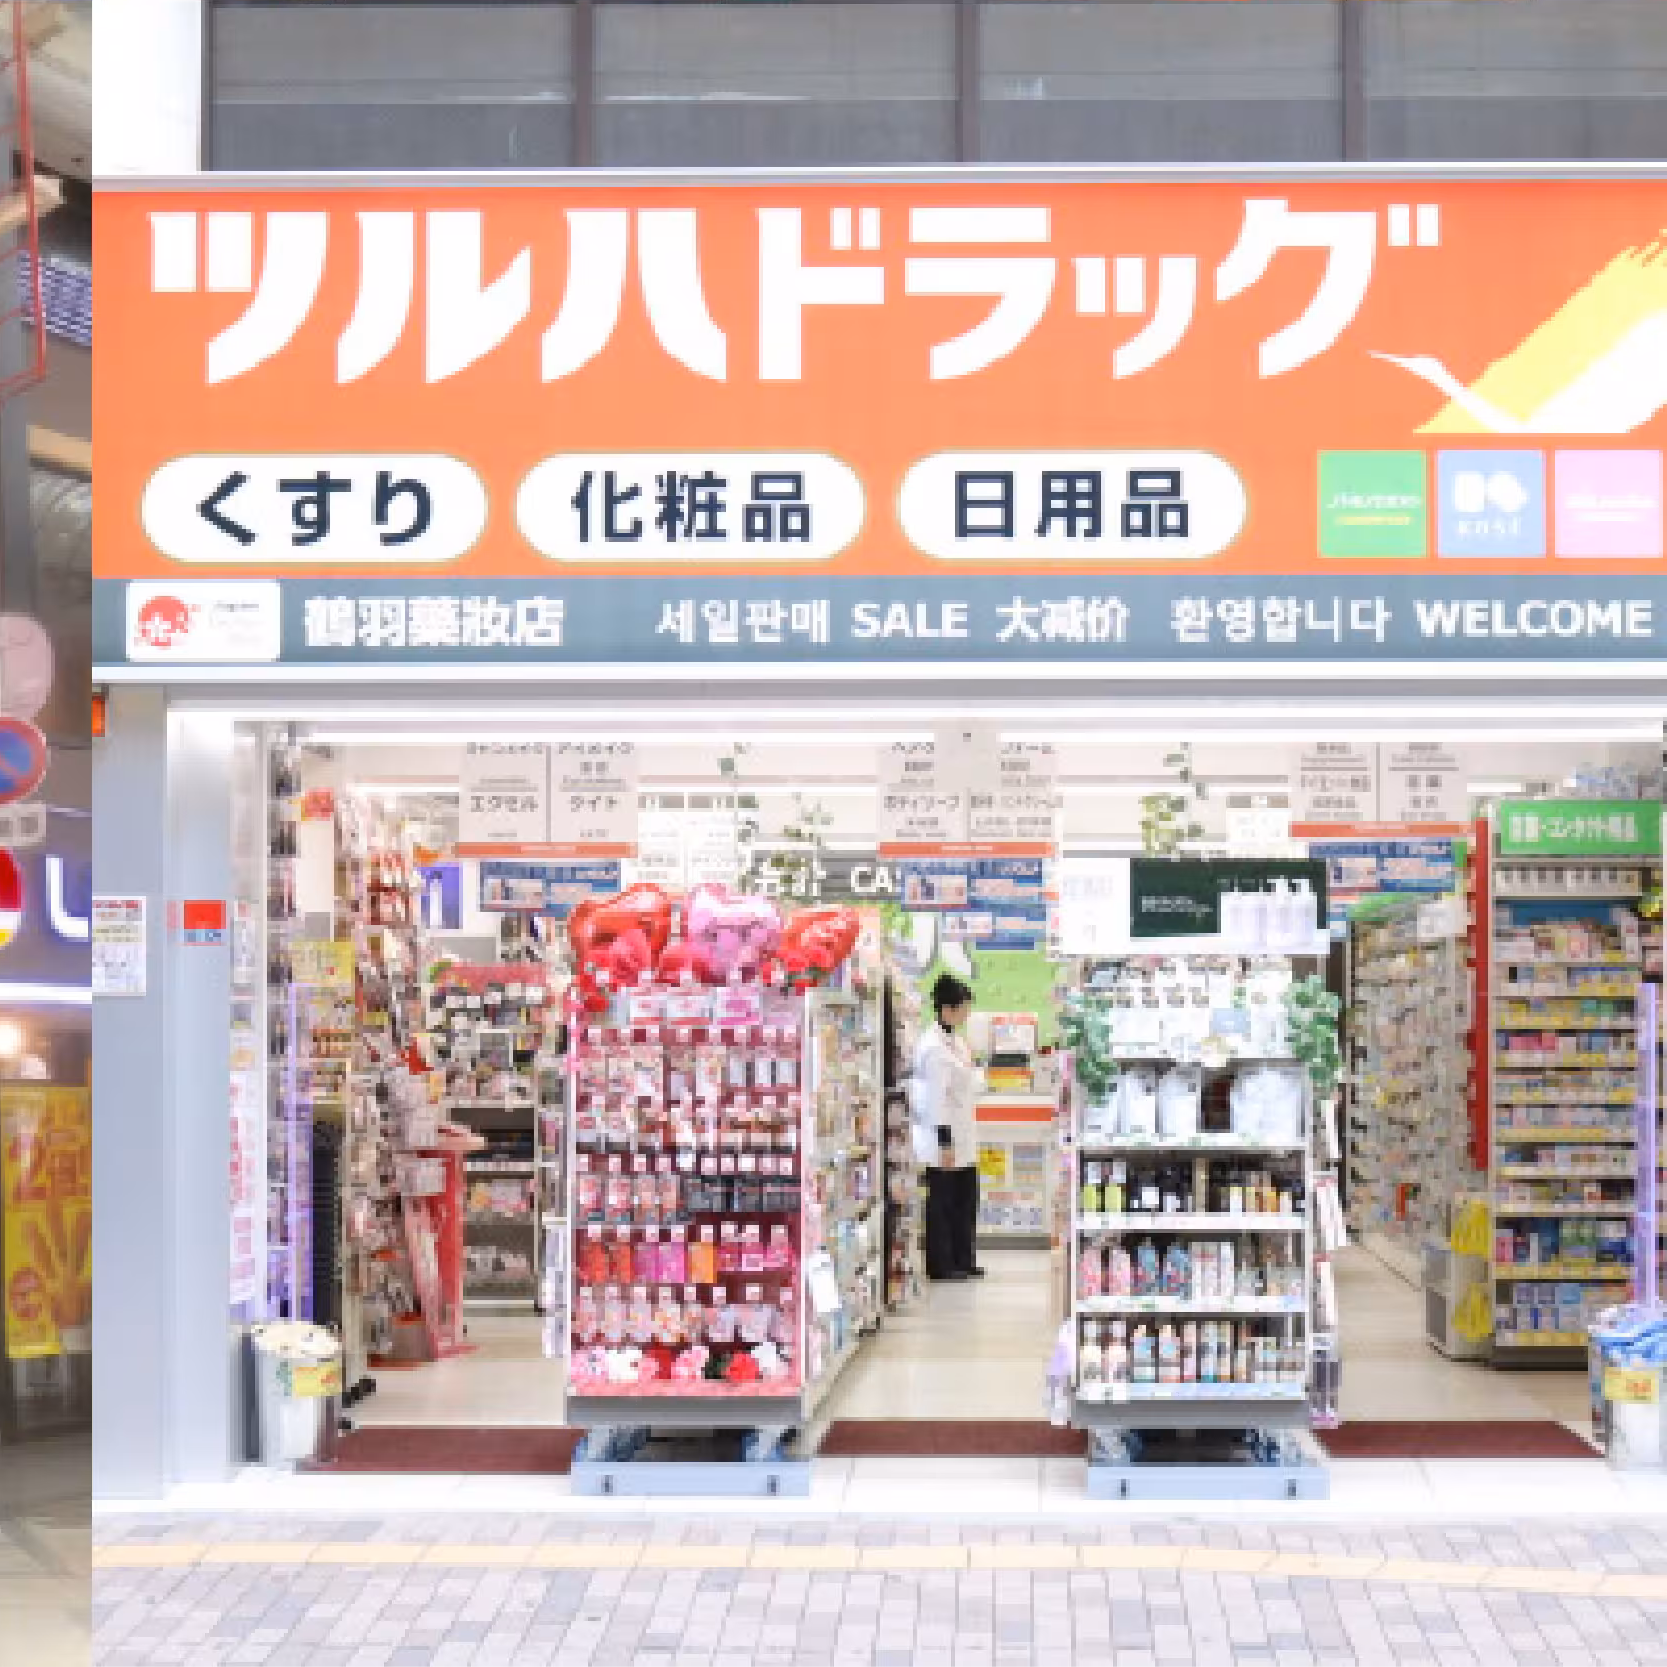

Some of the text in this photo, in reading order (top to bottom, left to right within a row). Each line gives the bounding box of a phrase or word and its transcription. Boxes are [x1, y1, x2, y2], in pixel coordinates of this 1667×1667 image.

[148, 197, 1442, 385] ツルハドラッグ
[196, 470, 435, 547] くすり
[570, 470, 813, 544] 化粧品
[953, 470, 1190, 540] 日用品
[850, 601, 969, 640] SALE
[1170, 596, 1392, 645] 환영합니다
[1416, 600, 1653, 638] WELCOME
